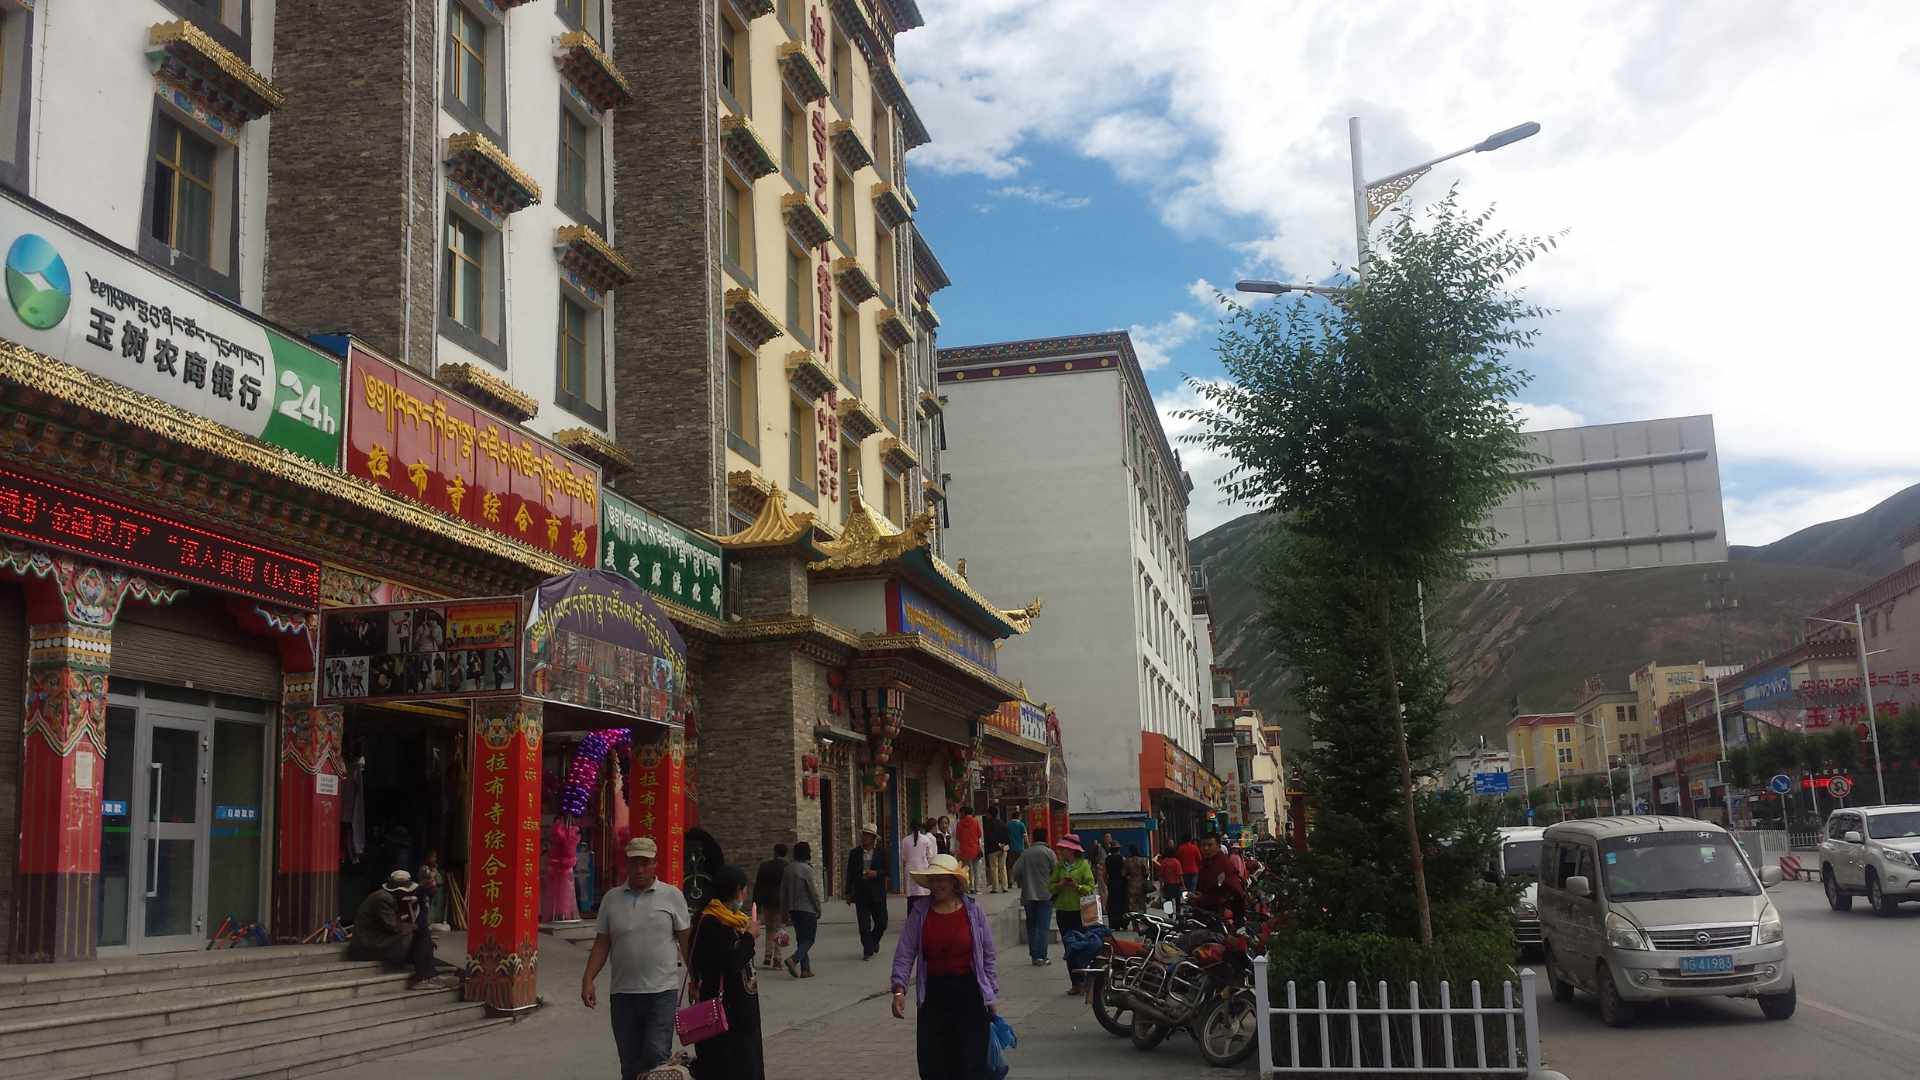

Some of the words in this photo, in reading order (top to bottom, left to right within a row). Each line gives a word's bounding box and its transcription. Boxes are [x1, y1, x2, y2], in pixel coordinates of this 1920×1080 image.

[86, 307, 263, 411] 玉树农商银行
[279, 369, 336, 435] 24h
[367, 442, 588, 558] 拉布寺综合市场
[481, 752, 510, 929] 拉布寺综合市场
[639, 771, 660, 840] 拉布寺
